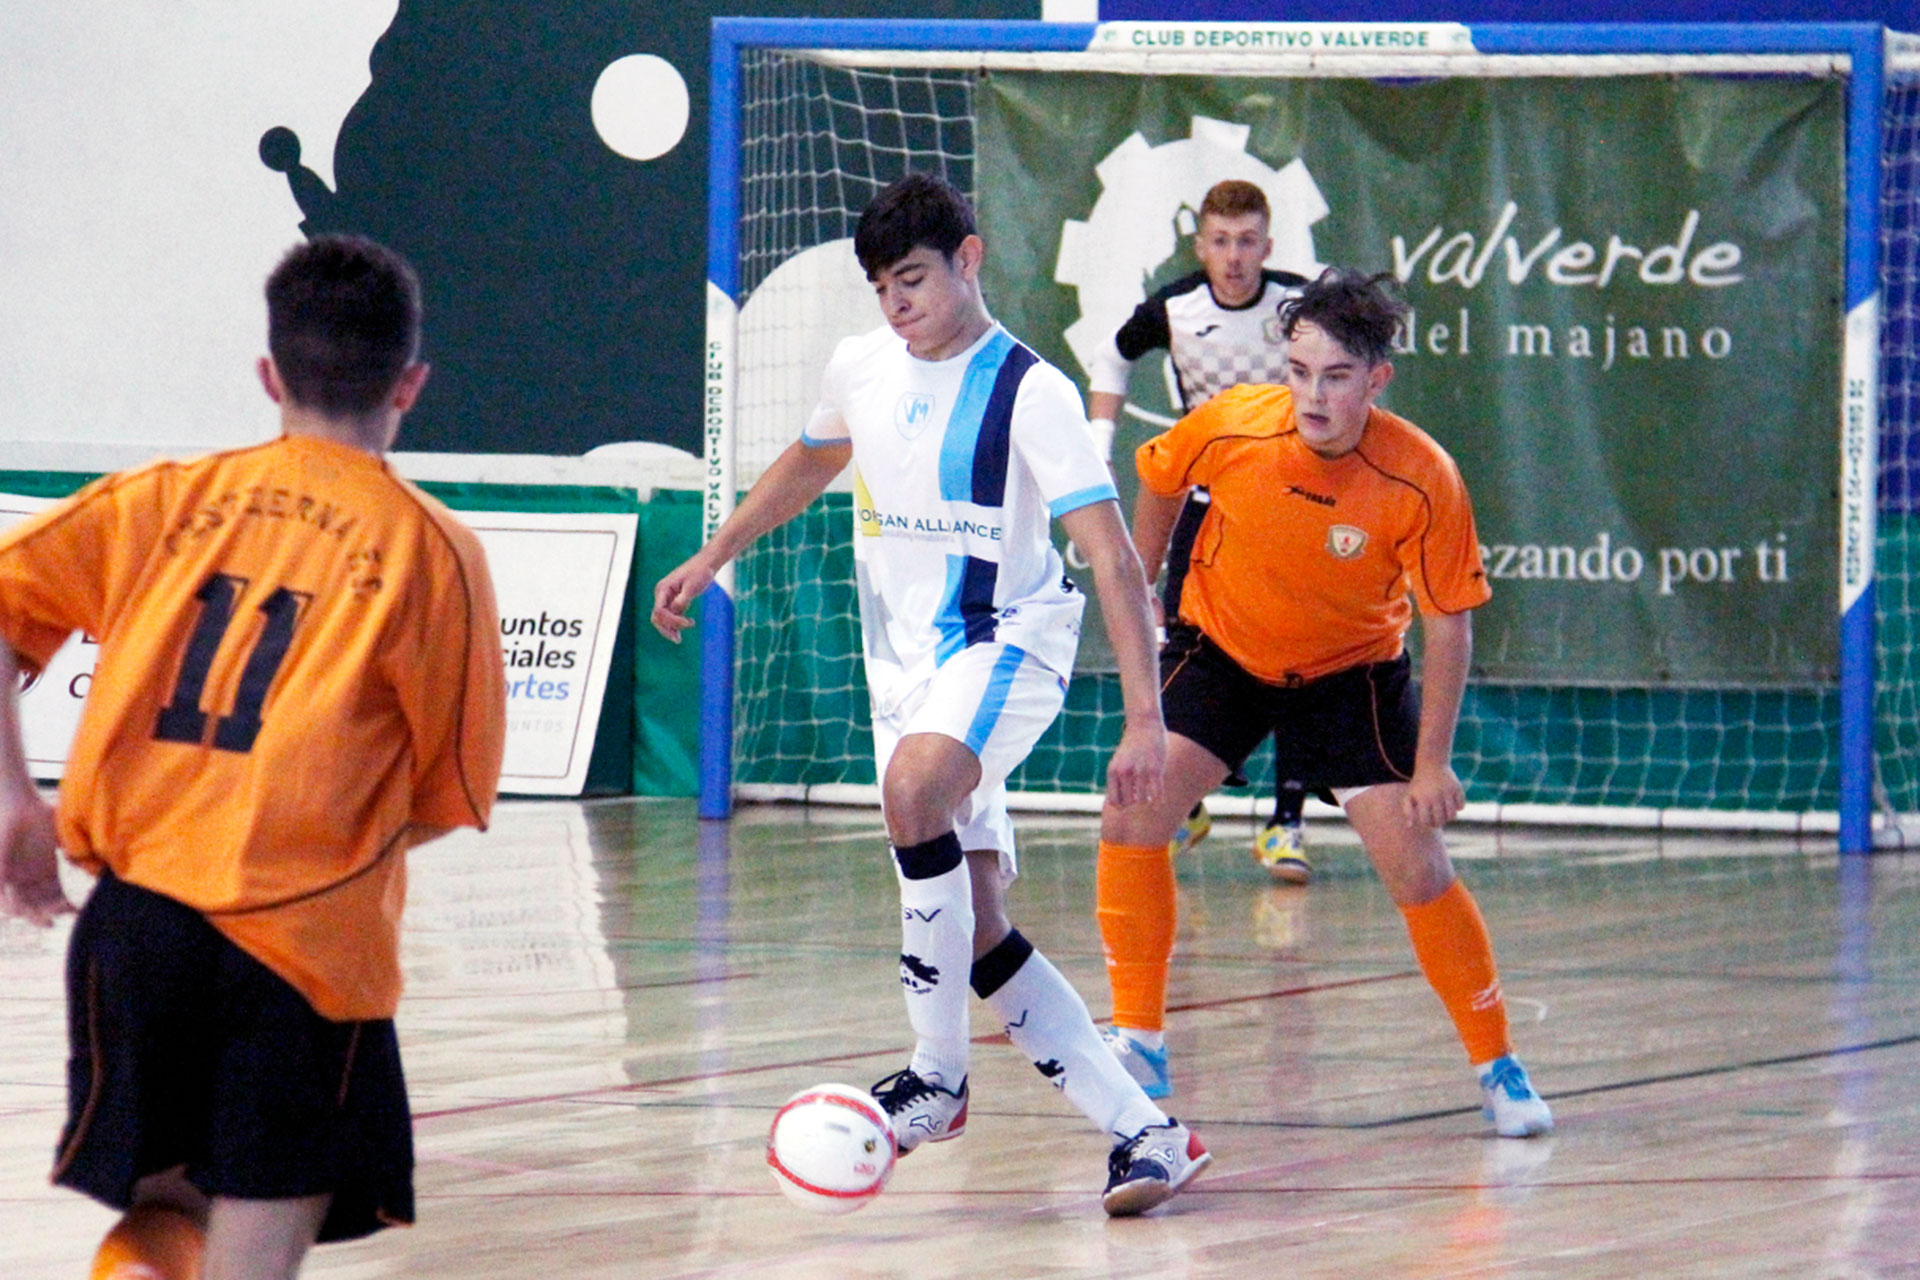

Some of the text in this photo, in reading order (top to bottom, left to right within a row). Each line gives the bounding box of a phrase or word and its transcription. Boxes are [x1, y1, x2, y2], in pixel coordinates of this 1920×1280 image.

[1131, 29, 1429, 47] CLUB DEPORTIVO VALVERDE
[1392, 200, 1745, 288] valverde
[1390, 306, 1733, 371] del majano
[914, 517, 1002, 541] ALLIANCE
[1657, 548, 1741, 596] por
[1755, 531, 1789, 582] ti
[500, 610, 583, 638] untos
[152, 572, 313, 755] 11
[503, 640, 577, 669] iales
